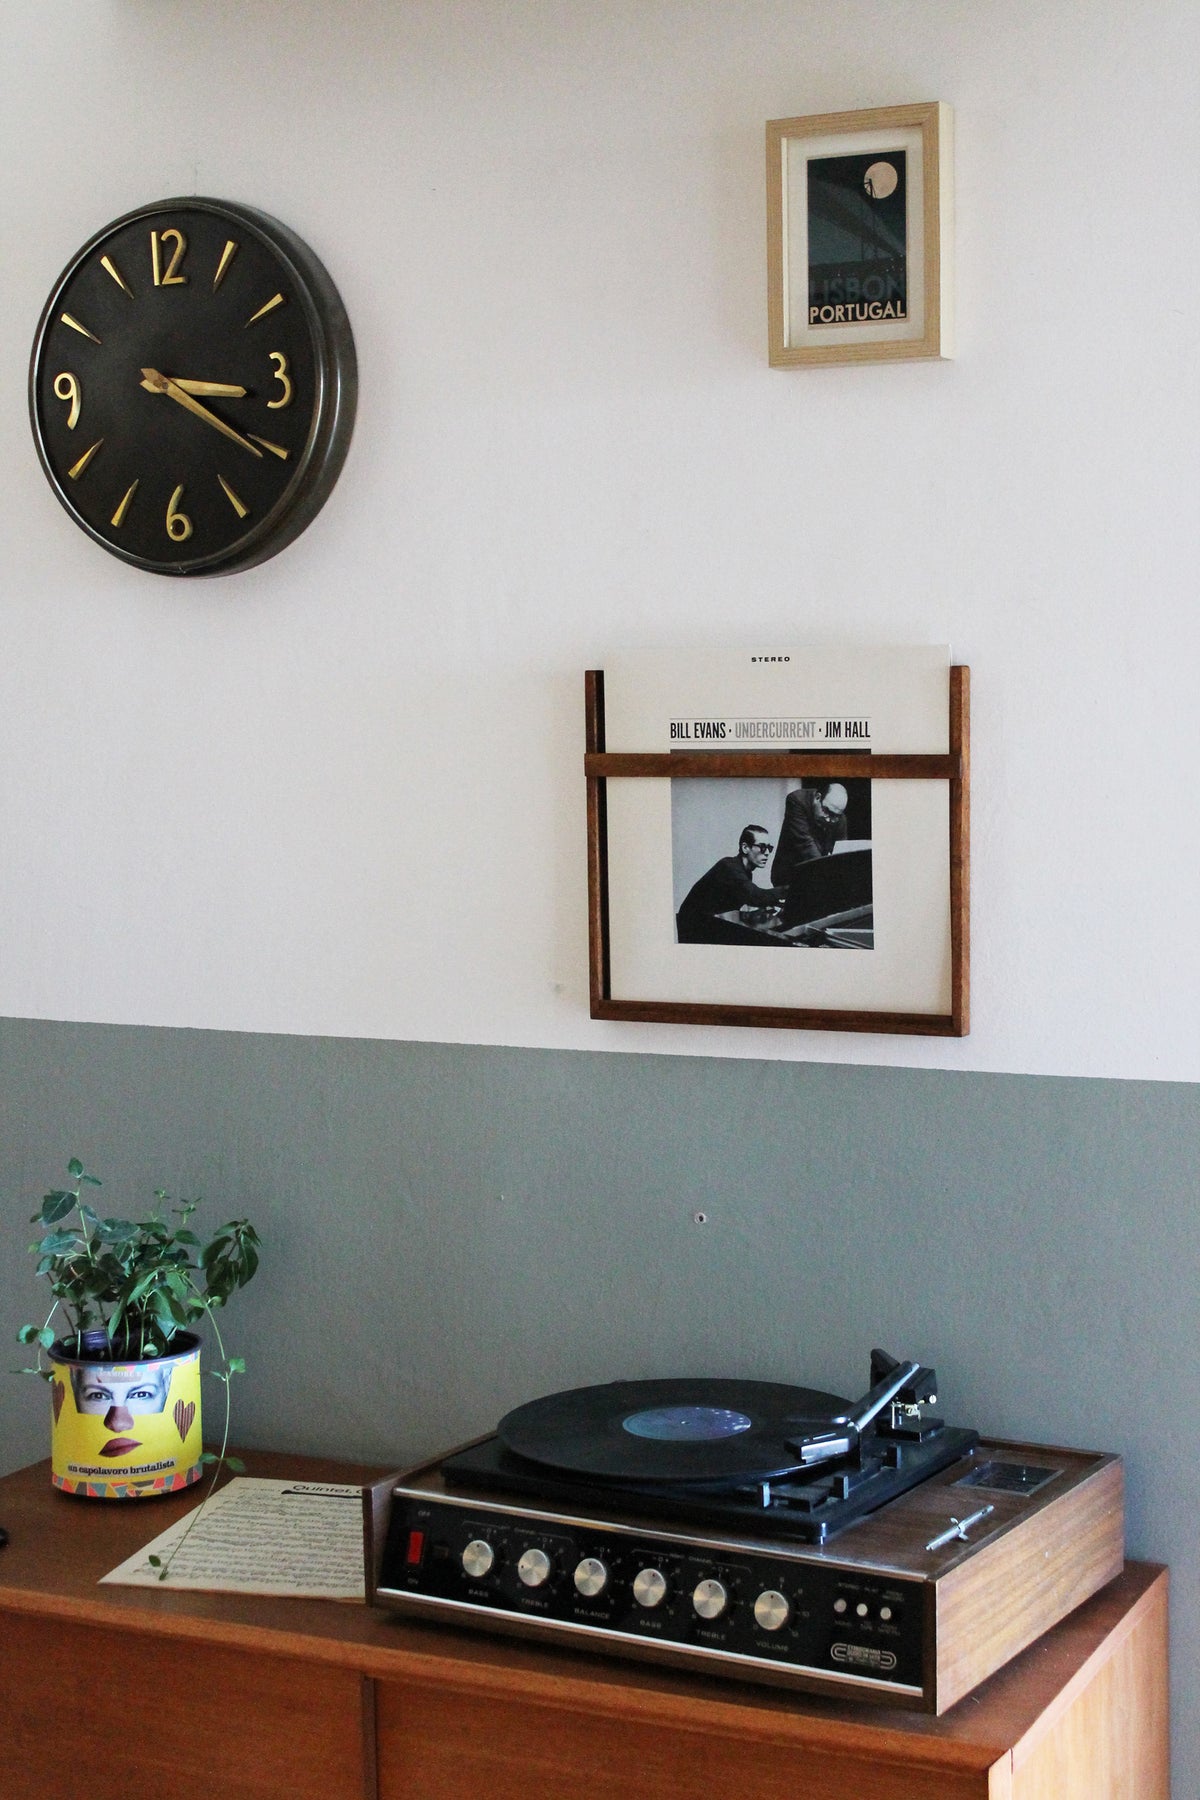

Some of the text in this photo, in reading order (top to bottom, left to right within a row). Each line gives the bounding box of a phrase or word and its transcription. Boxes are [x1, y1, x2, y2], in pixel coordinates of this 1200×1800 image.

[151, 229, 187, 287] 12
[809, 300, 906, 324] PORTUGAL
[266, 351, 293, 409] 3
[53, 372, 82, 430] 9
[166, 484, 193, 542] 6
[670, 721, 871, 739] BILL EVANS UNDERCURRENT JIM HALL
[79, 1466, 129, 1477] capolavoro
[130, 1460, 175, 1474] brutalista
[574, 1607, 610, 1619] BALANCE
[755, 1640, 789, 1652] VOLUME
